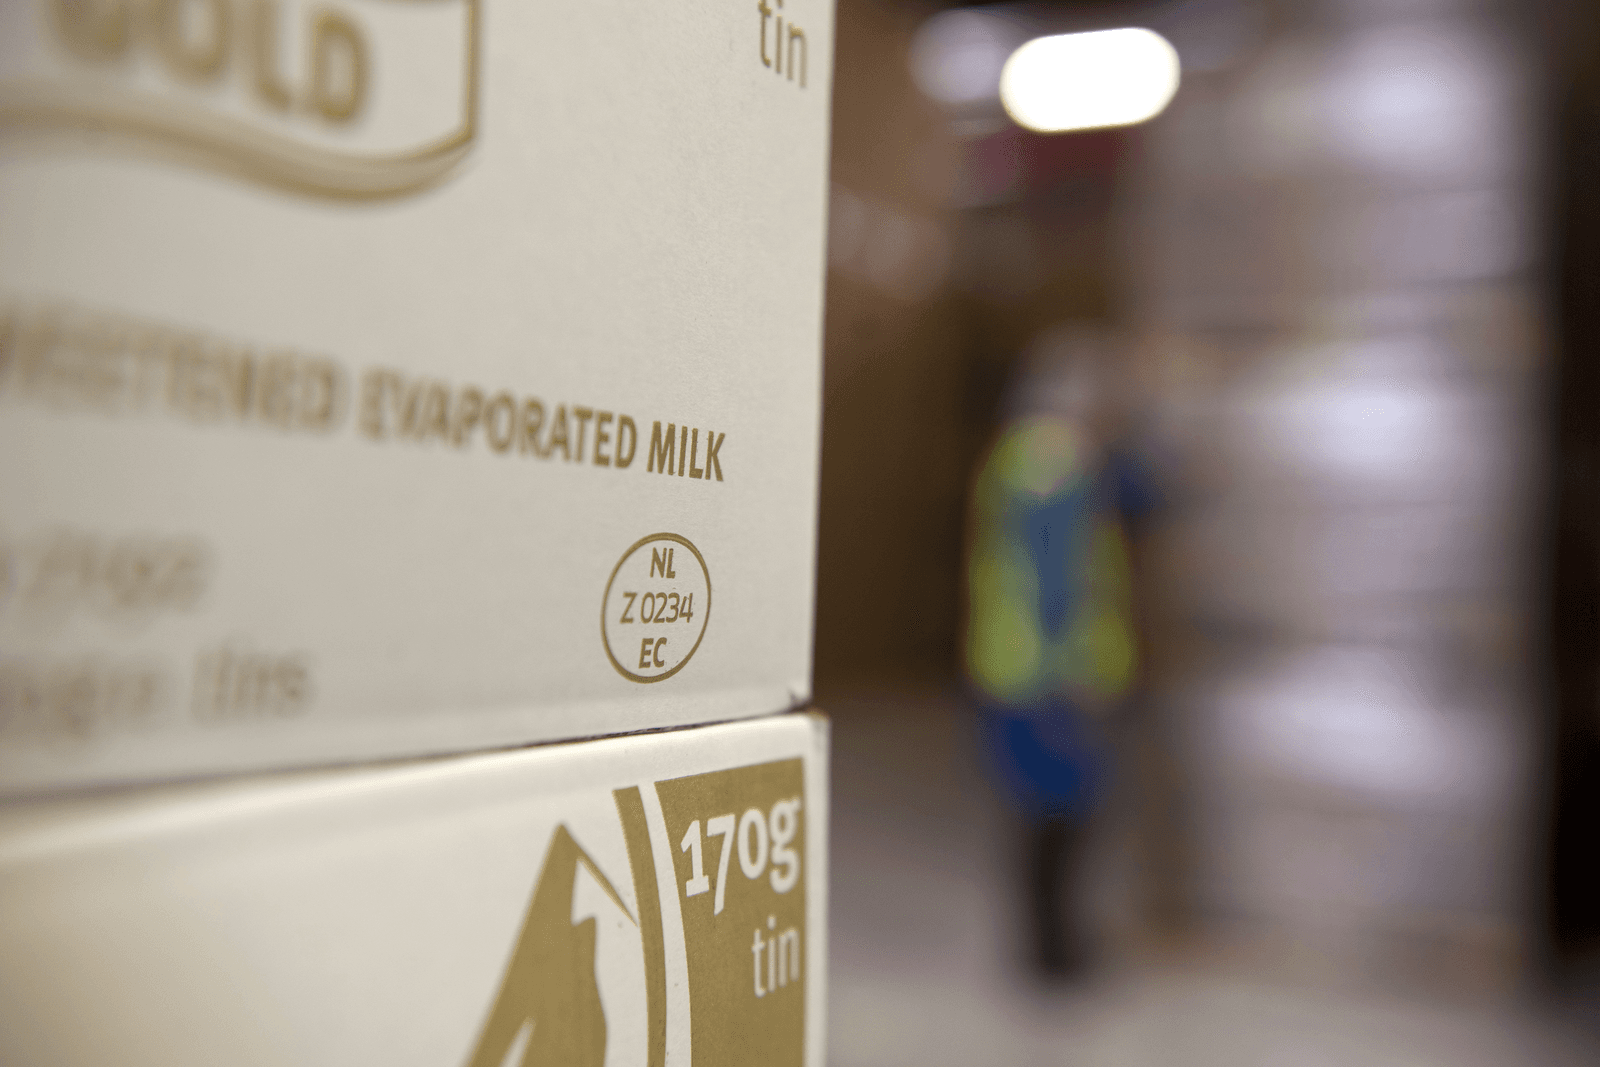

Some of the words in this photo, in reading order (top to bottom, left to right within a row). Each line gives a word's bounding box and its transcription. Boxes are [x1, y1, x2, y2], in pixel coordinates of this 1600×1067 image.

[757, 0, 807, 89] tin
[359, 367, 638, 469] EVAPORATED
[646, 420, 725, 482] MILK
[649, 547, 676, 579] NL
[619, 591, 638, 624] Z
[640, 591, 694, 624] 0234
[638, 636, 668, 669] EC
[680, 798, 800, 916] 170g
[751, 915, 799, 998] tin
